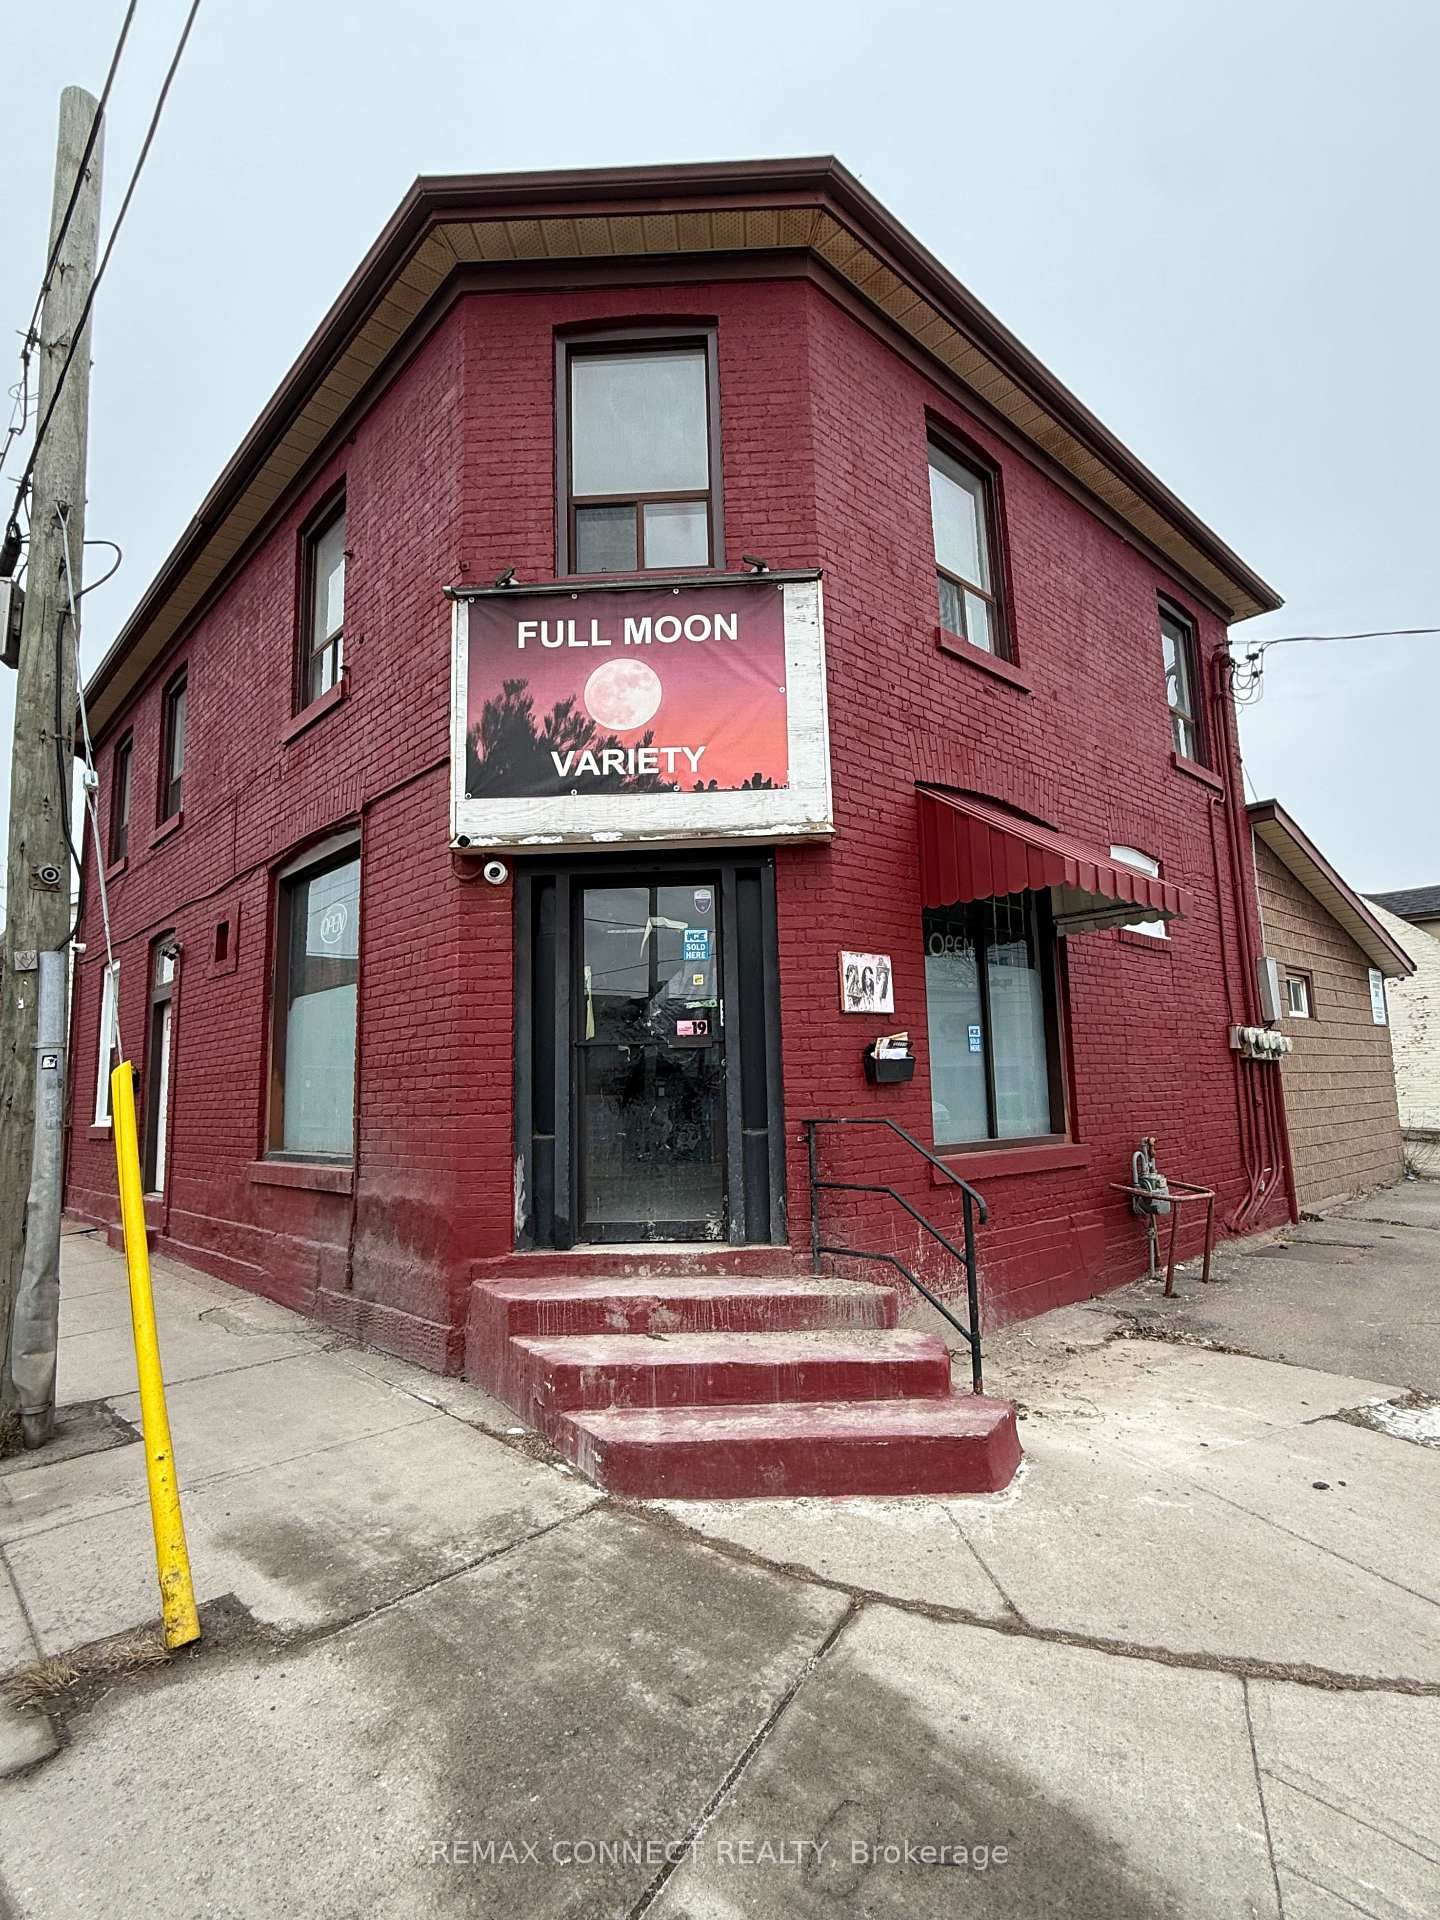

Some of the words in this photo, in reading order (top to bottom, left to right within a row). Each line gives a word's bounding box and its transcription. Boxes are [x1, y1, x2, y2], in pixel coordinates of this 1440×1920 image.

[516, 618, 612, 649] FULL
[623, 613, 738, 645] MOON
[551, 745, 706, 777] VARIETY
[686, 943, 706, 951] SOLD
[685, 951, 706, 960] HERE
[691, 1021, 707, 1035] 19
